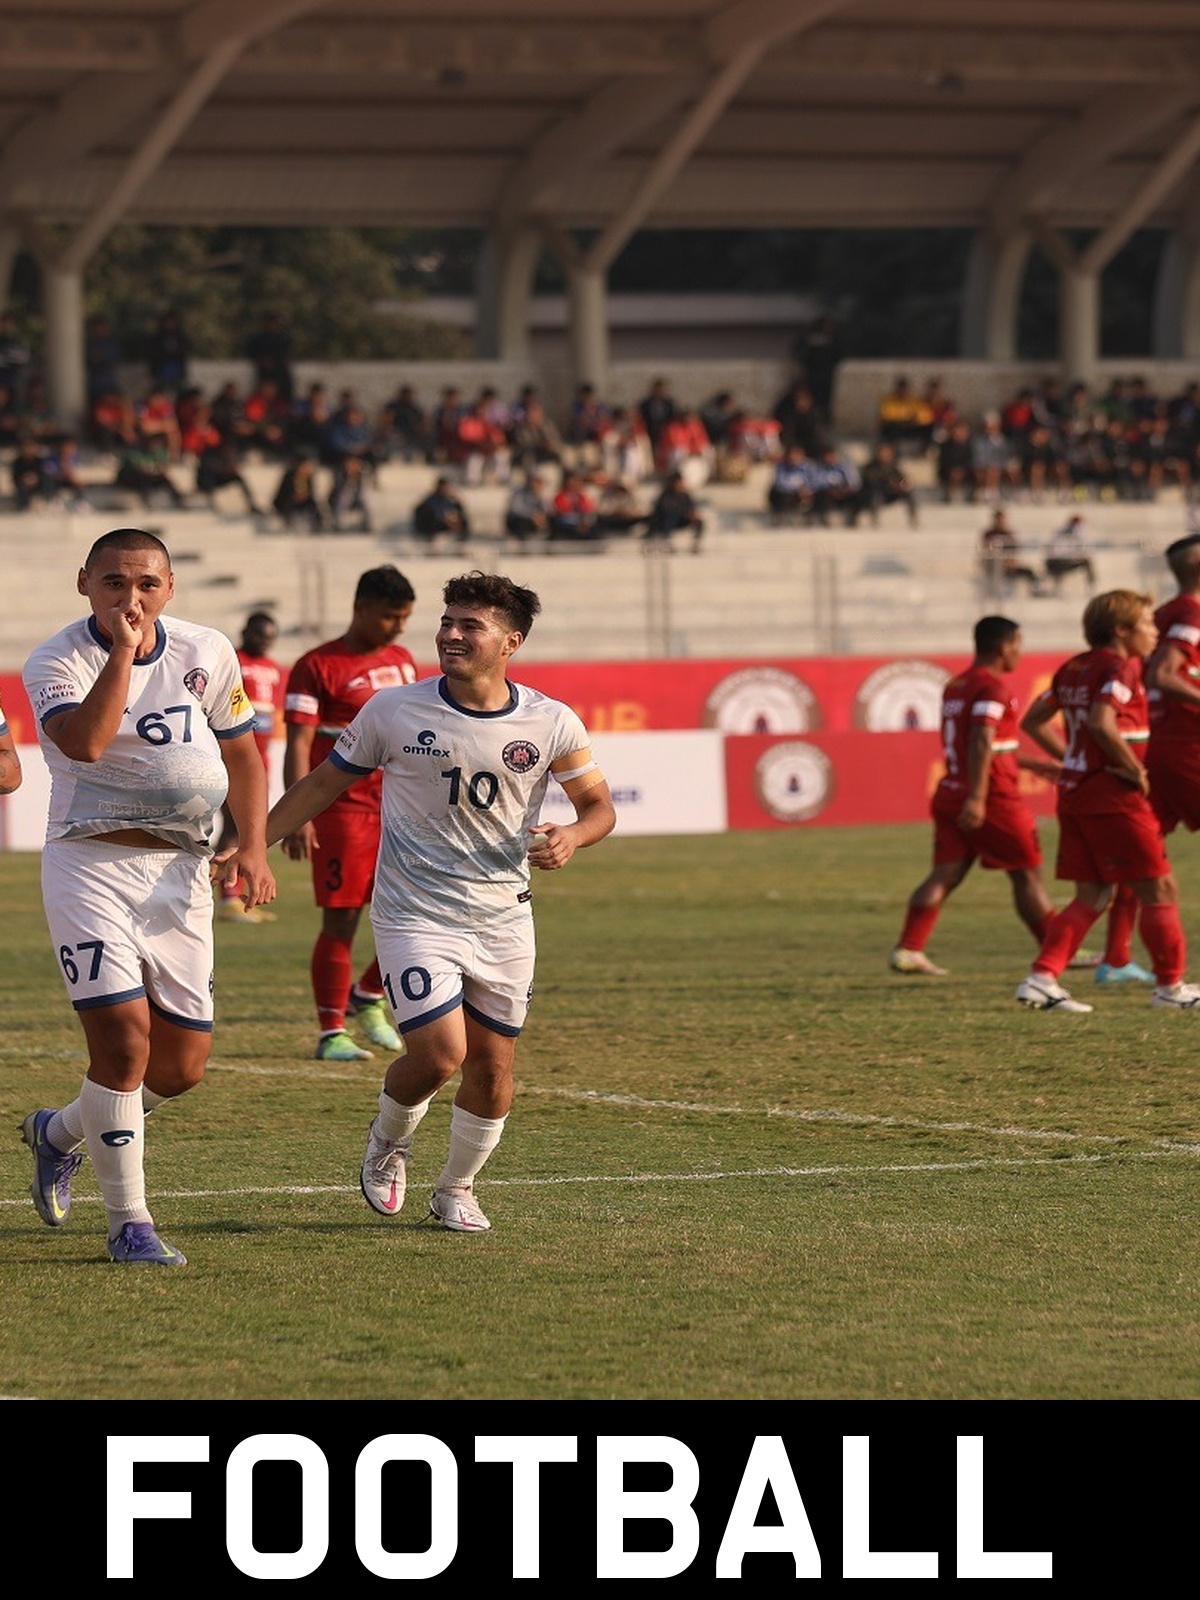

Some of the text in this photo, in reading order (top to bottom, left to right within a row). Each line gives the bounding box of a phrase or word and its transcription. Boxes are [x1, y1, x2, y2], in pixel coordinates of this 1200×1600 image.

[136, 705, 192, 746] 67
[402, 745, 451, 758] omtex
[441, 766, 499, 810] 10
[325, 858, 344, 892] 3
[60, 940, 105, 985] 67
[383, 966, 432, 1010] 10
